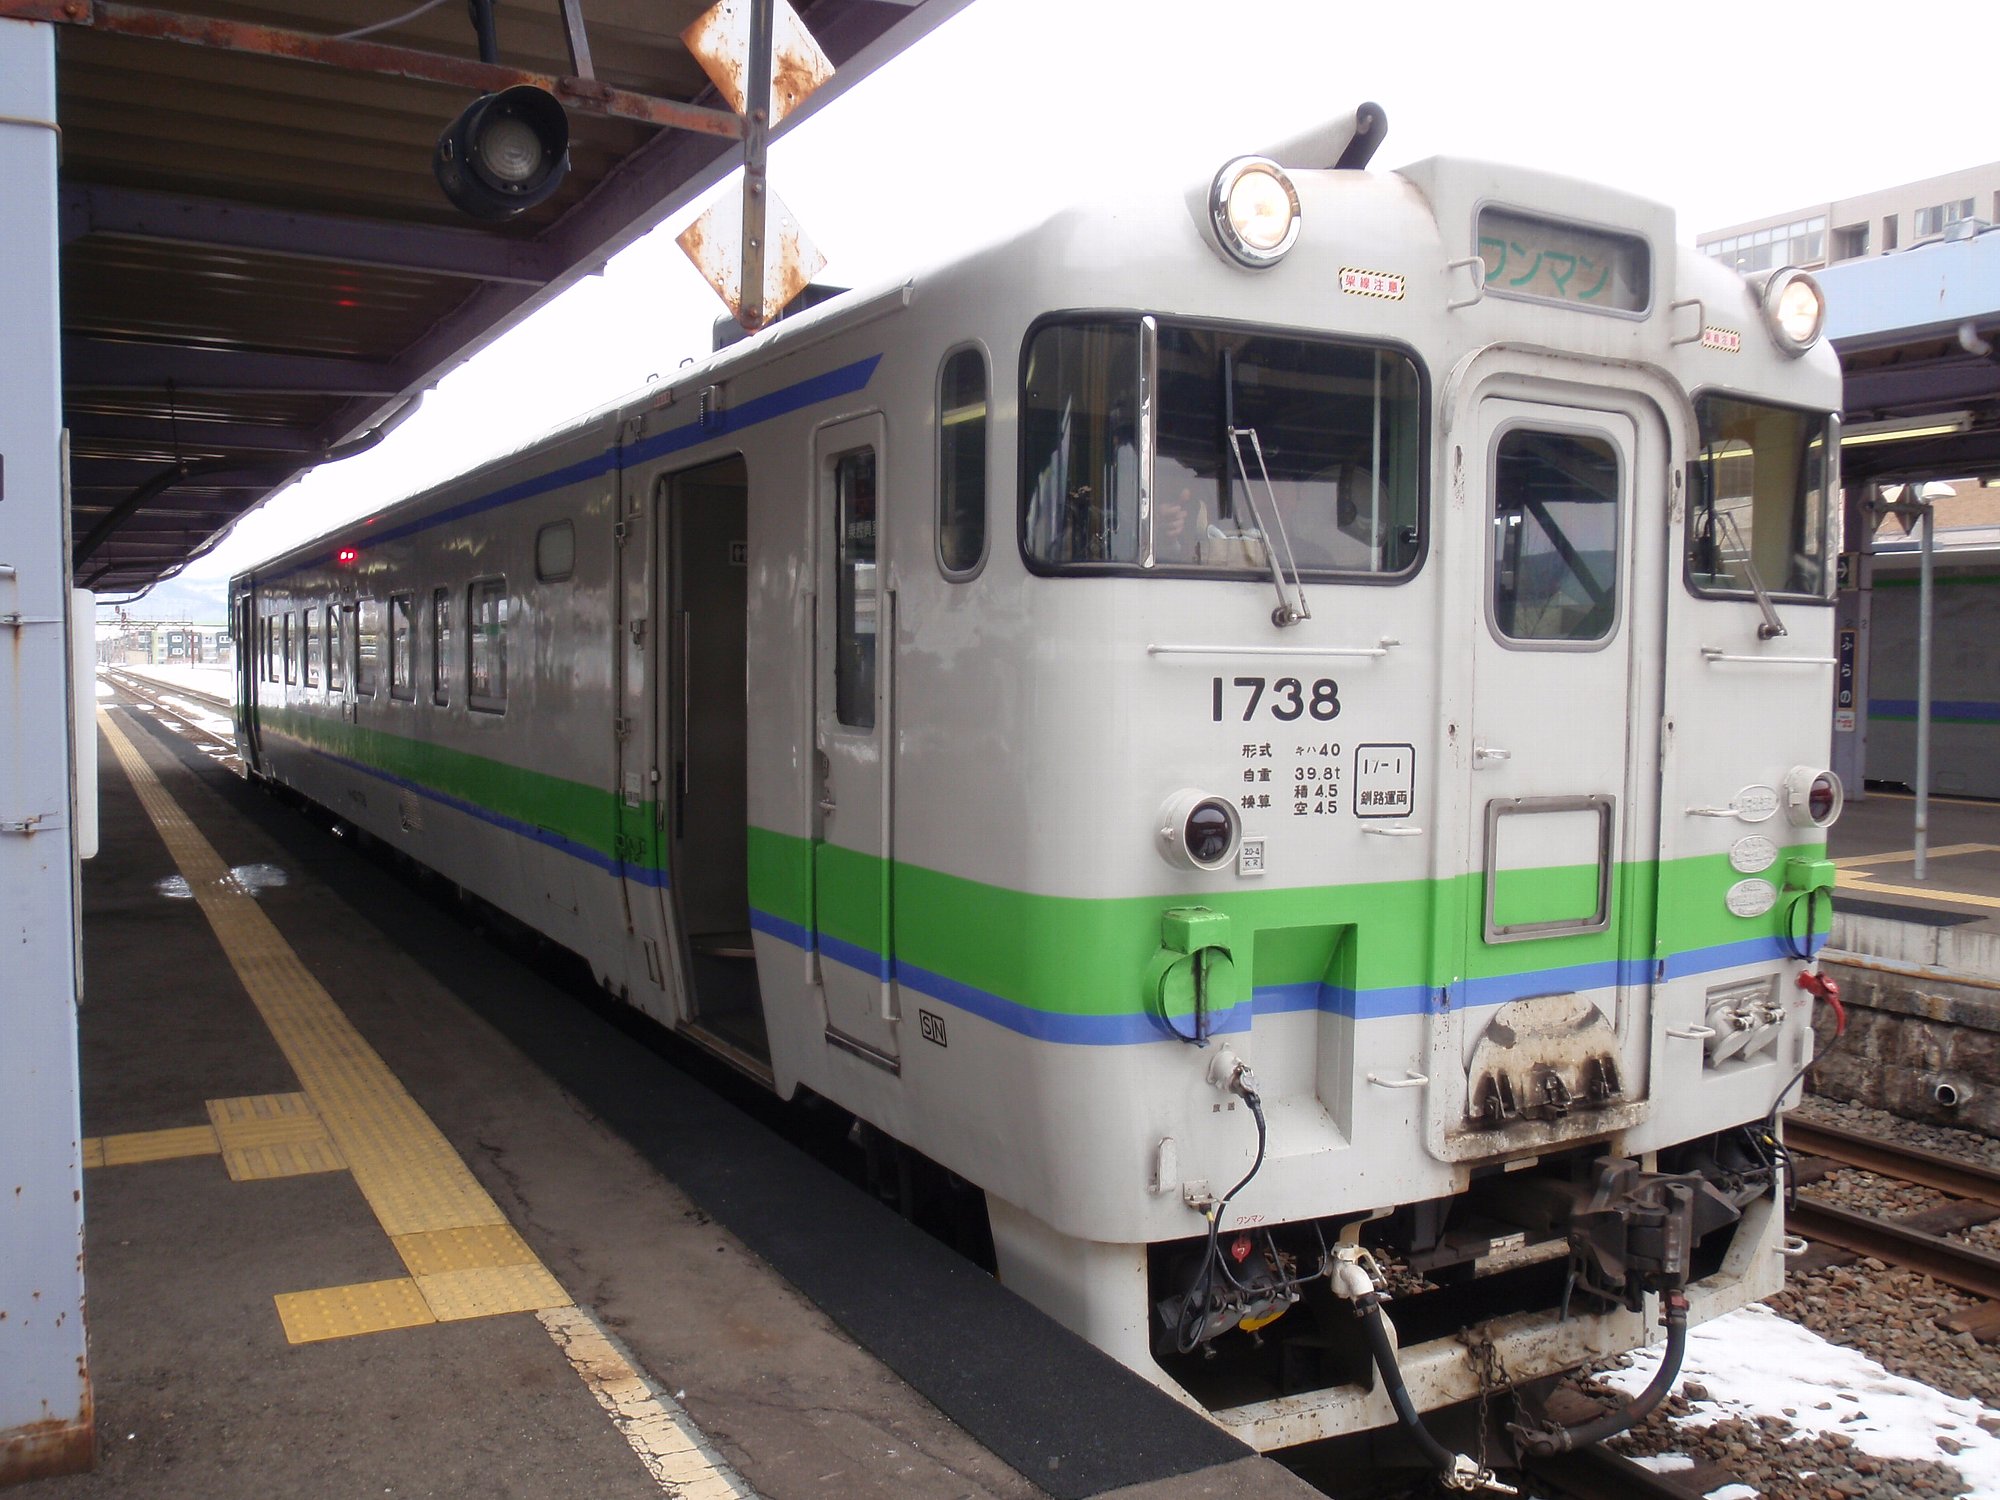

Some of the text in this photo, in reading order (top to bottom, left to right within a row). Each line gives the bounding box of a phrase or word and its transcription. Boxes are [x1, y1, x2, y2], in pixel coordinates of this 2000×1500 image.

[1840, 636, 1853, 704] ふらの
[1212, 676, 1342, 722] 1738
[1242, 742, 1272, 758] 形式
[1243, 766, 1341, 782] 自重 39.8t
[1315, 783, 1338, 798] 4.5
[1293, 800, 1337, 816] 空 4.5
[922, 1015, 945, 1042] SN
[1236, 1213, 1265, 1225] ワンマン
